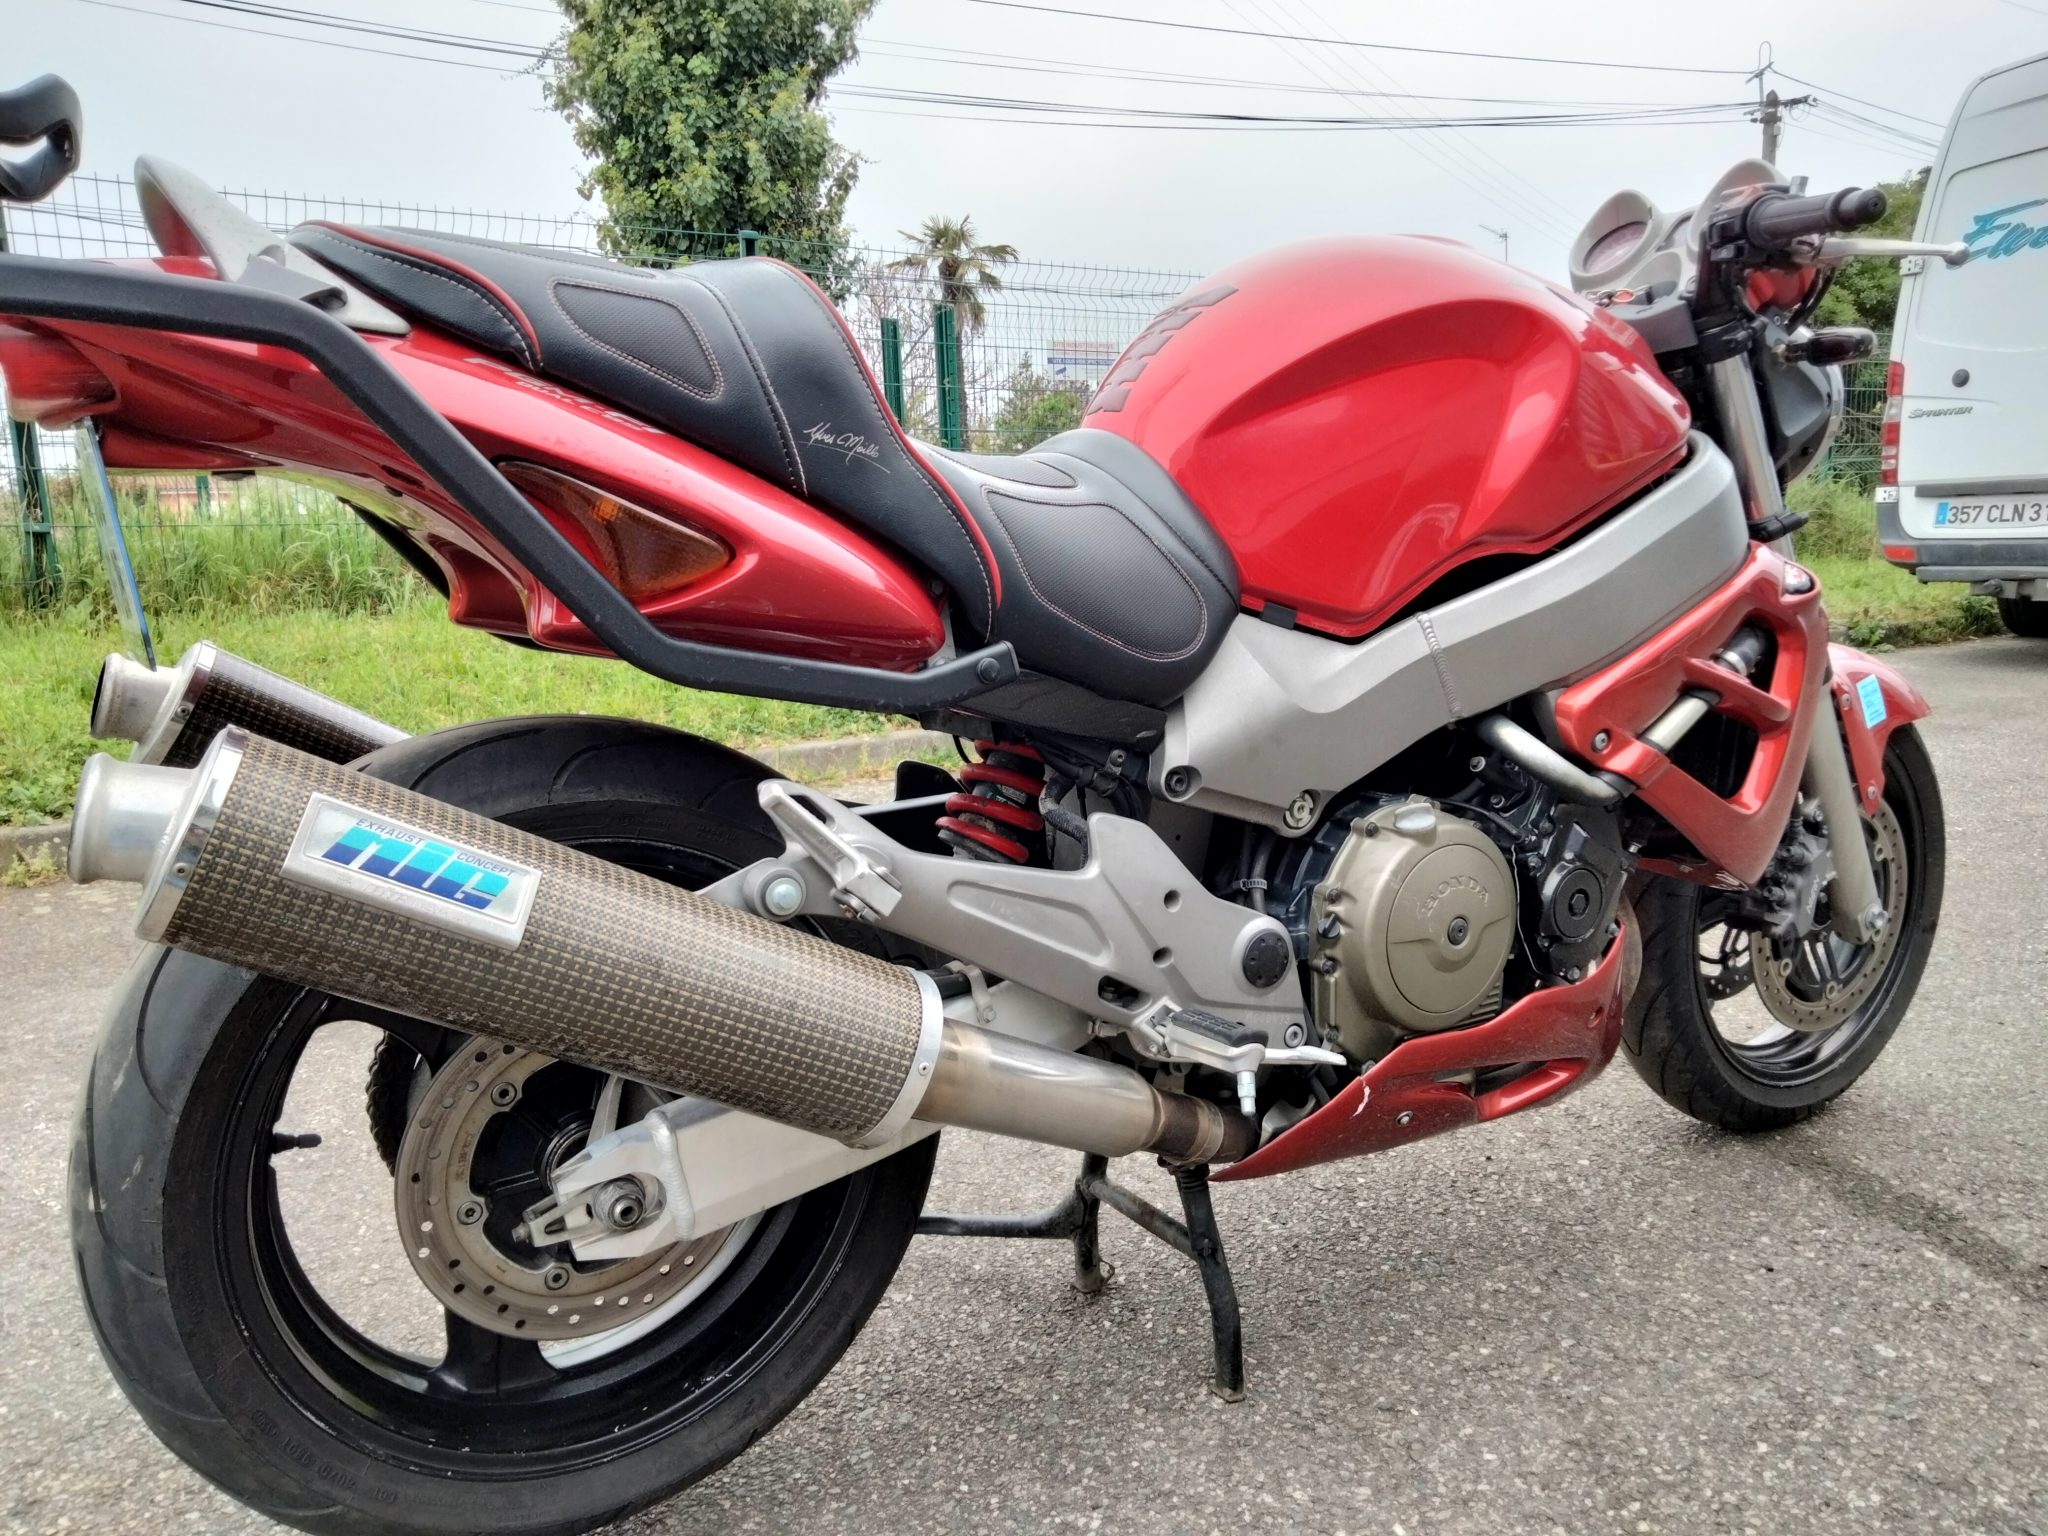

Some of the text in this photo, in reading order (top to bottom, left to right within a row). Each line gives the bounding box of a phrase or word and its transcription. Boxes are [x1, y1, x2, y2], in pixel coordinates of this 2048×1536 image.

[1947, 505, 1984, 524] 357
[1986, 503, 2026, 523] CLN
[355, 818, 427, 846] EXHAUST
[456, 852, 515, 877] CONCEPT
[1421, 875, 1488, 918] HONDA
